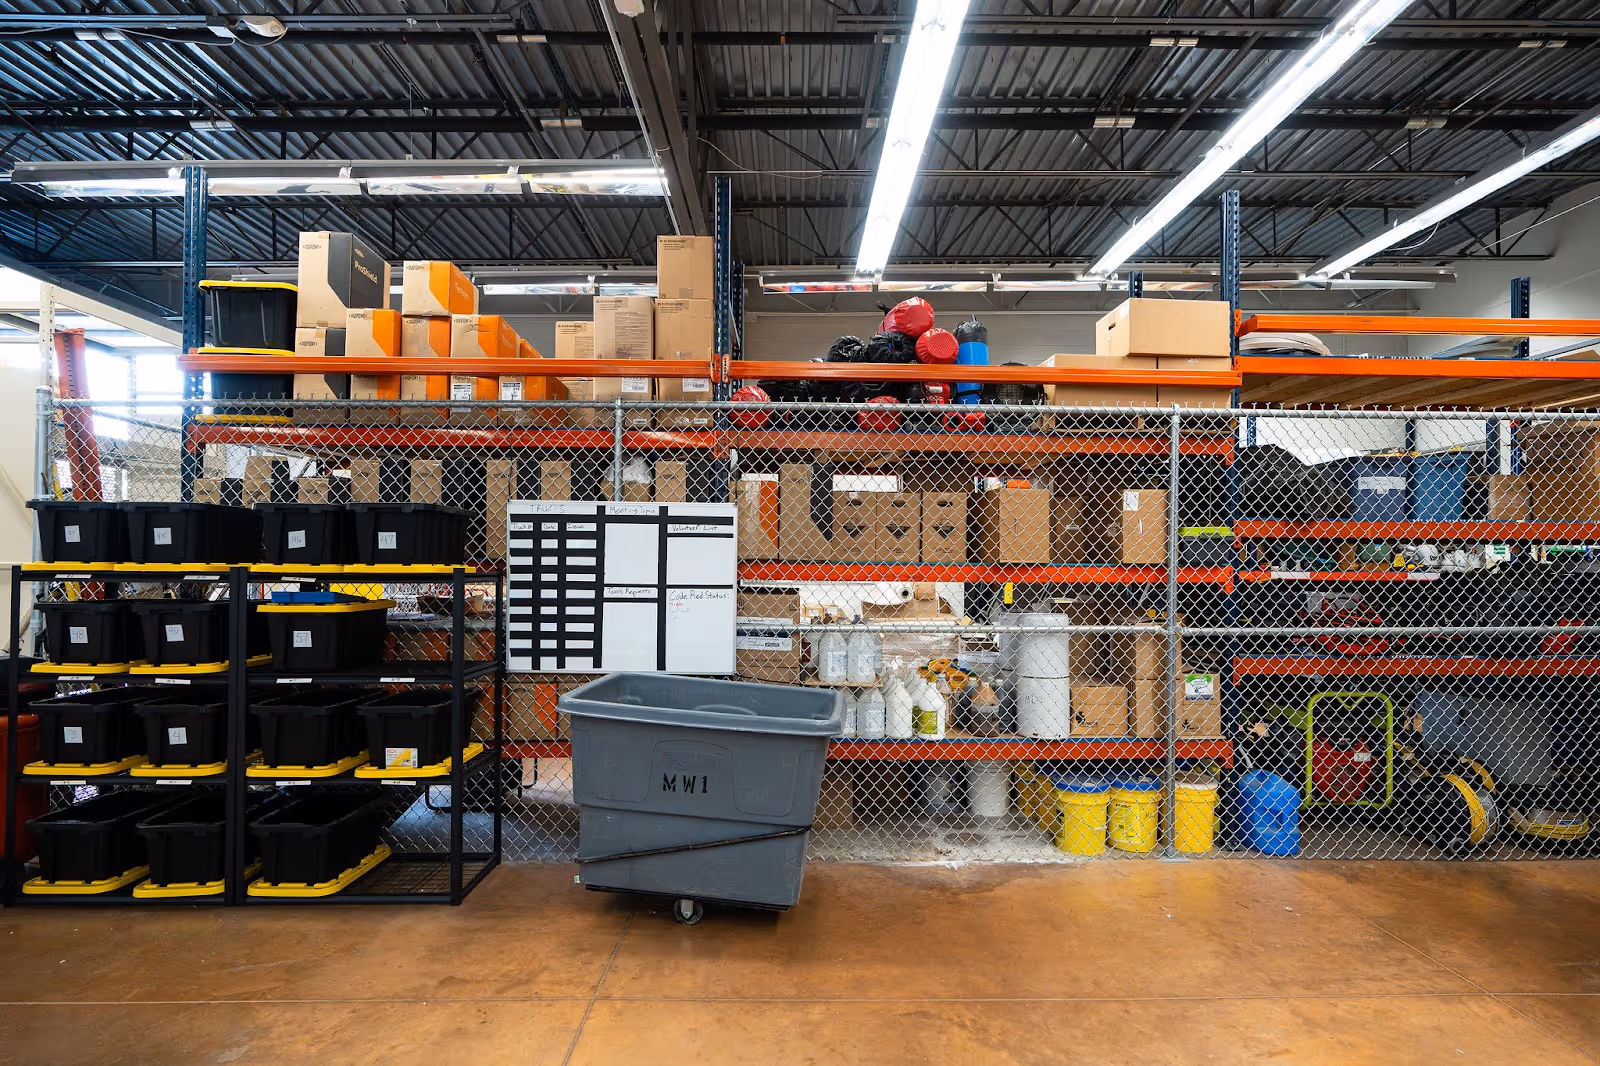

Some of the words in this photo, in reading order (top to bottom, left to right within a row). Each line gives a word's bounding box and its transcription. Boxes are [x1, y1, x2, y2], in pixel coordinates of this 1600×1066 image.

[354, 260, 378, 284] ProShield
[609, 506, 638, 515] Meeting
[671, 523, 700, 531] Volunteer
[669, 590, 689, 602] Code
[690, 589, 704, 600] Red
[705, 590, 730, 600] Status:
[173, 729, 181, 742] 4
